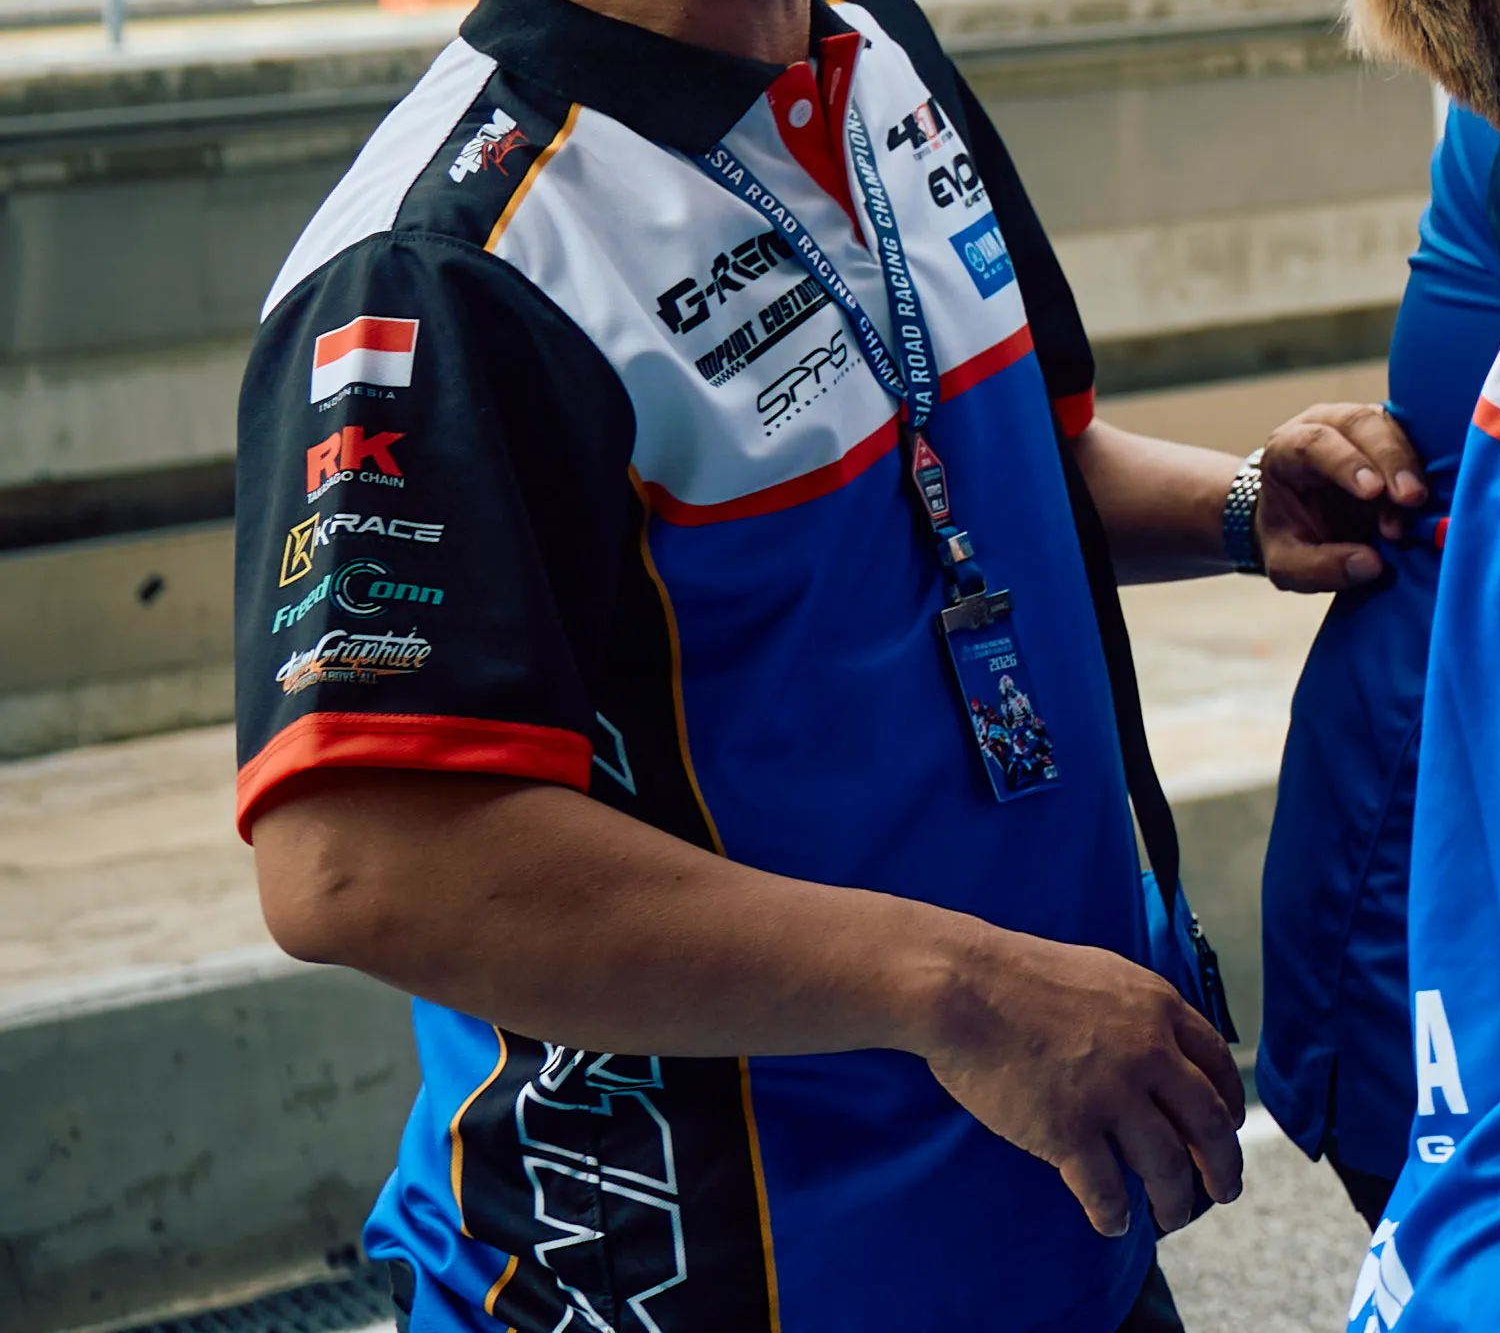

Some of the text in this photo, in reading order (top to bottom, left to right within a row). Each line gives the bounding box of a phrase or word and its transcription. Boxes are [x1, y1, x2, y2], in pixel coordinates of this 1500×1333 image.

[705, 148, 745, 187] SIA
[745, 182, 799, 234] ROAD
[797, 234, 858, 310] RACING
[882, 236, 917, 317] RACING
[901, 323, 932, 384] ROAD
[318, 385, 397, 413] INDONESIA
[913, 390, 933, 429] SIA
[306, 425, 407, 494] RK
[358, 470, 405, 489] CHAIN
